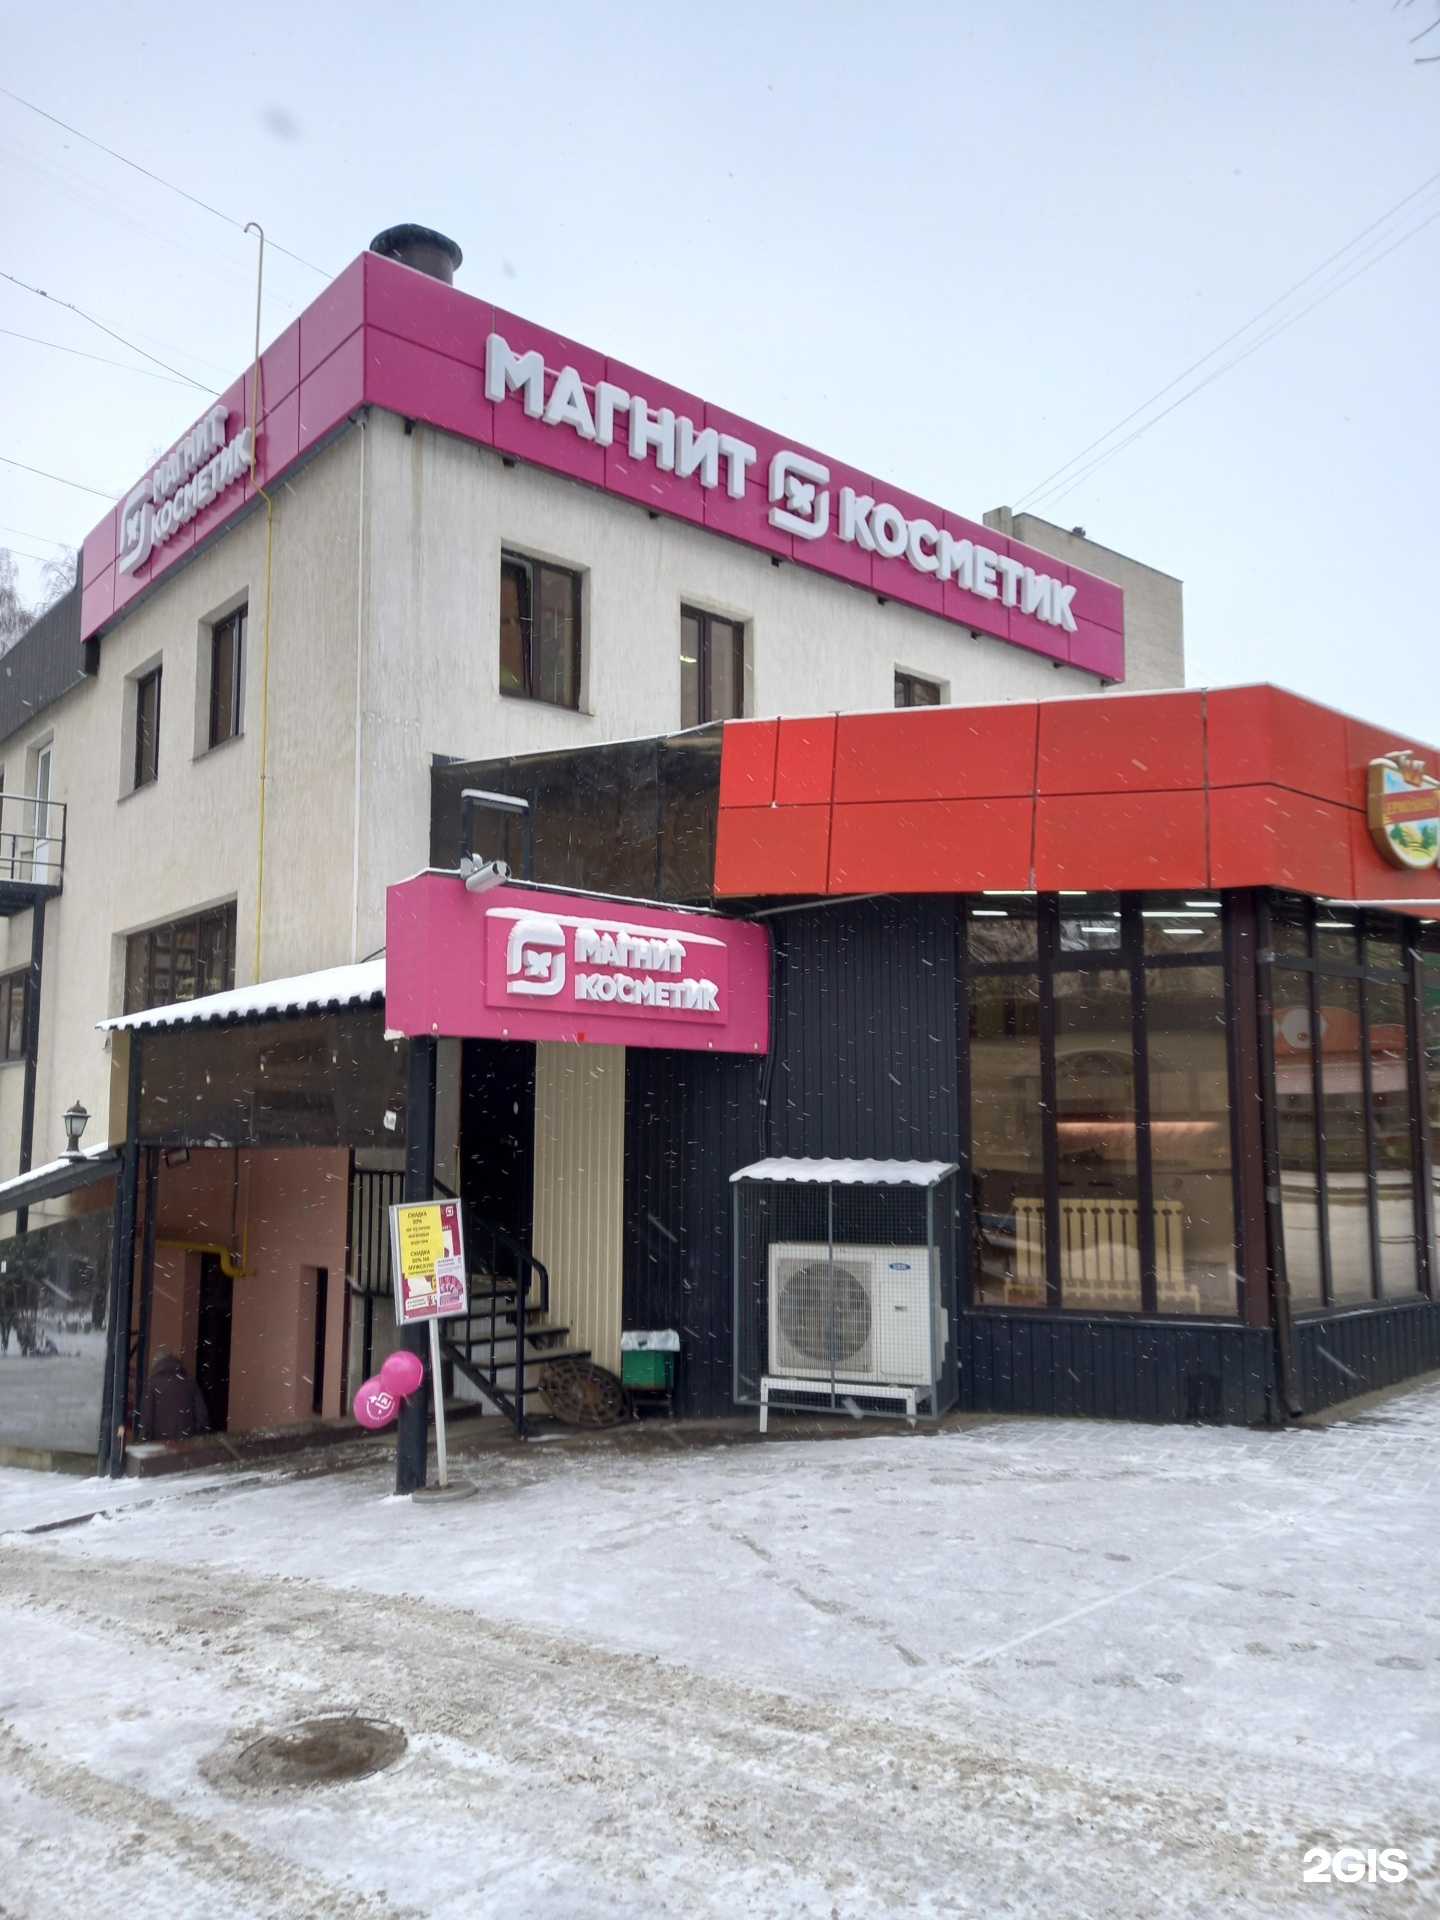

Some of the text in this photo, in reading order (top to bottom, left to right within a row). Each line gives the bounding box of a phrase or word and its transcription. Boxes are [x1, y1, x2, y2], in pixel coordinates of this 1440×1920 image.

[150, 427, 254, 547] КОСМЕТИК
[153, 404, 229, 505] МАГНИТ
[485, 333, 1080, 632] МАГНИТ КОСМЕТИК
[574, 973, 720, 1012] КОСМЕТИК
[575, 926, 686, 973] МАГНИТ
